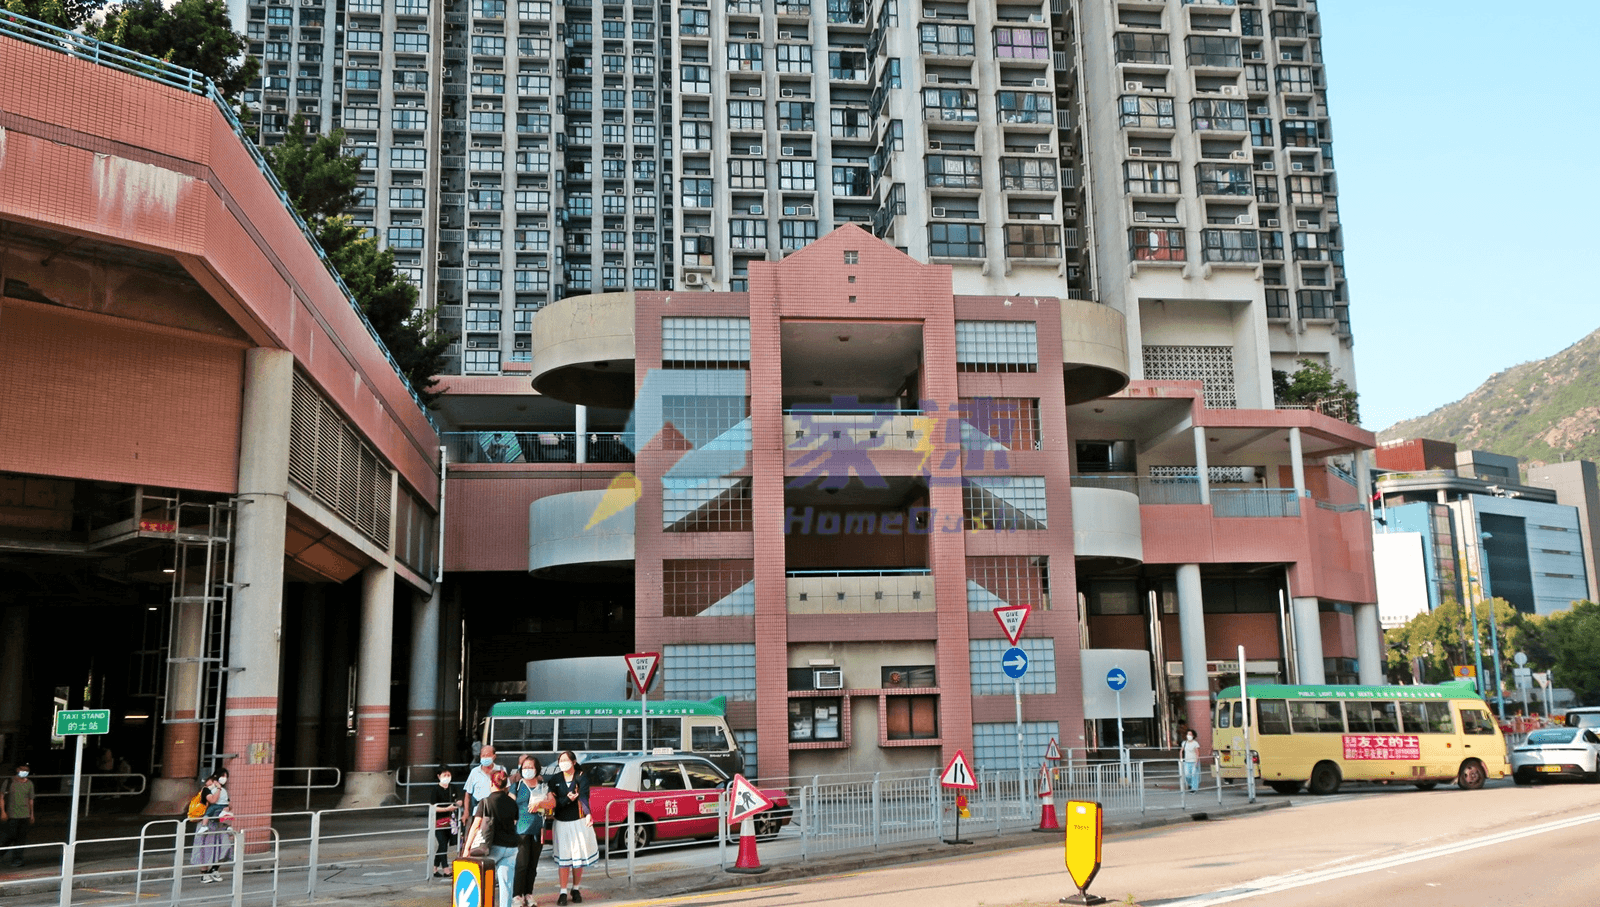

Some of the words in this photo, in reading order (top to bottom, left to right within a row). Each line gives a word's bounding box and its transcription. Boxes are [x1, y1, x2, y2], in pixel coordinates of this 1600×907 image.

[635, 657, 648, 665] GIVE
[81, 712, 106, 720] STAND
[67, 721, 98, 731] 的士站
[1357, 736, 1419, 748] 友文的士
[665, 807, 679, 815] TAXI
